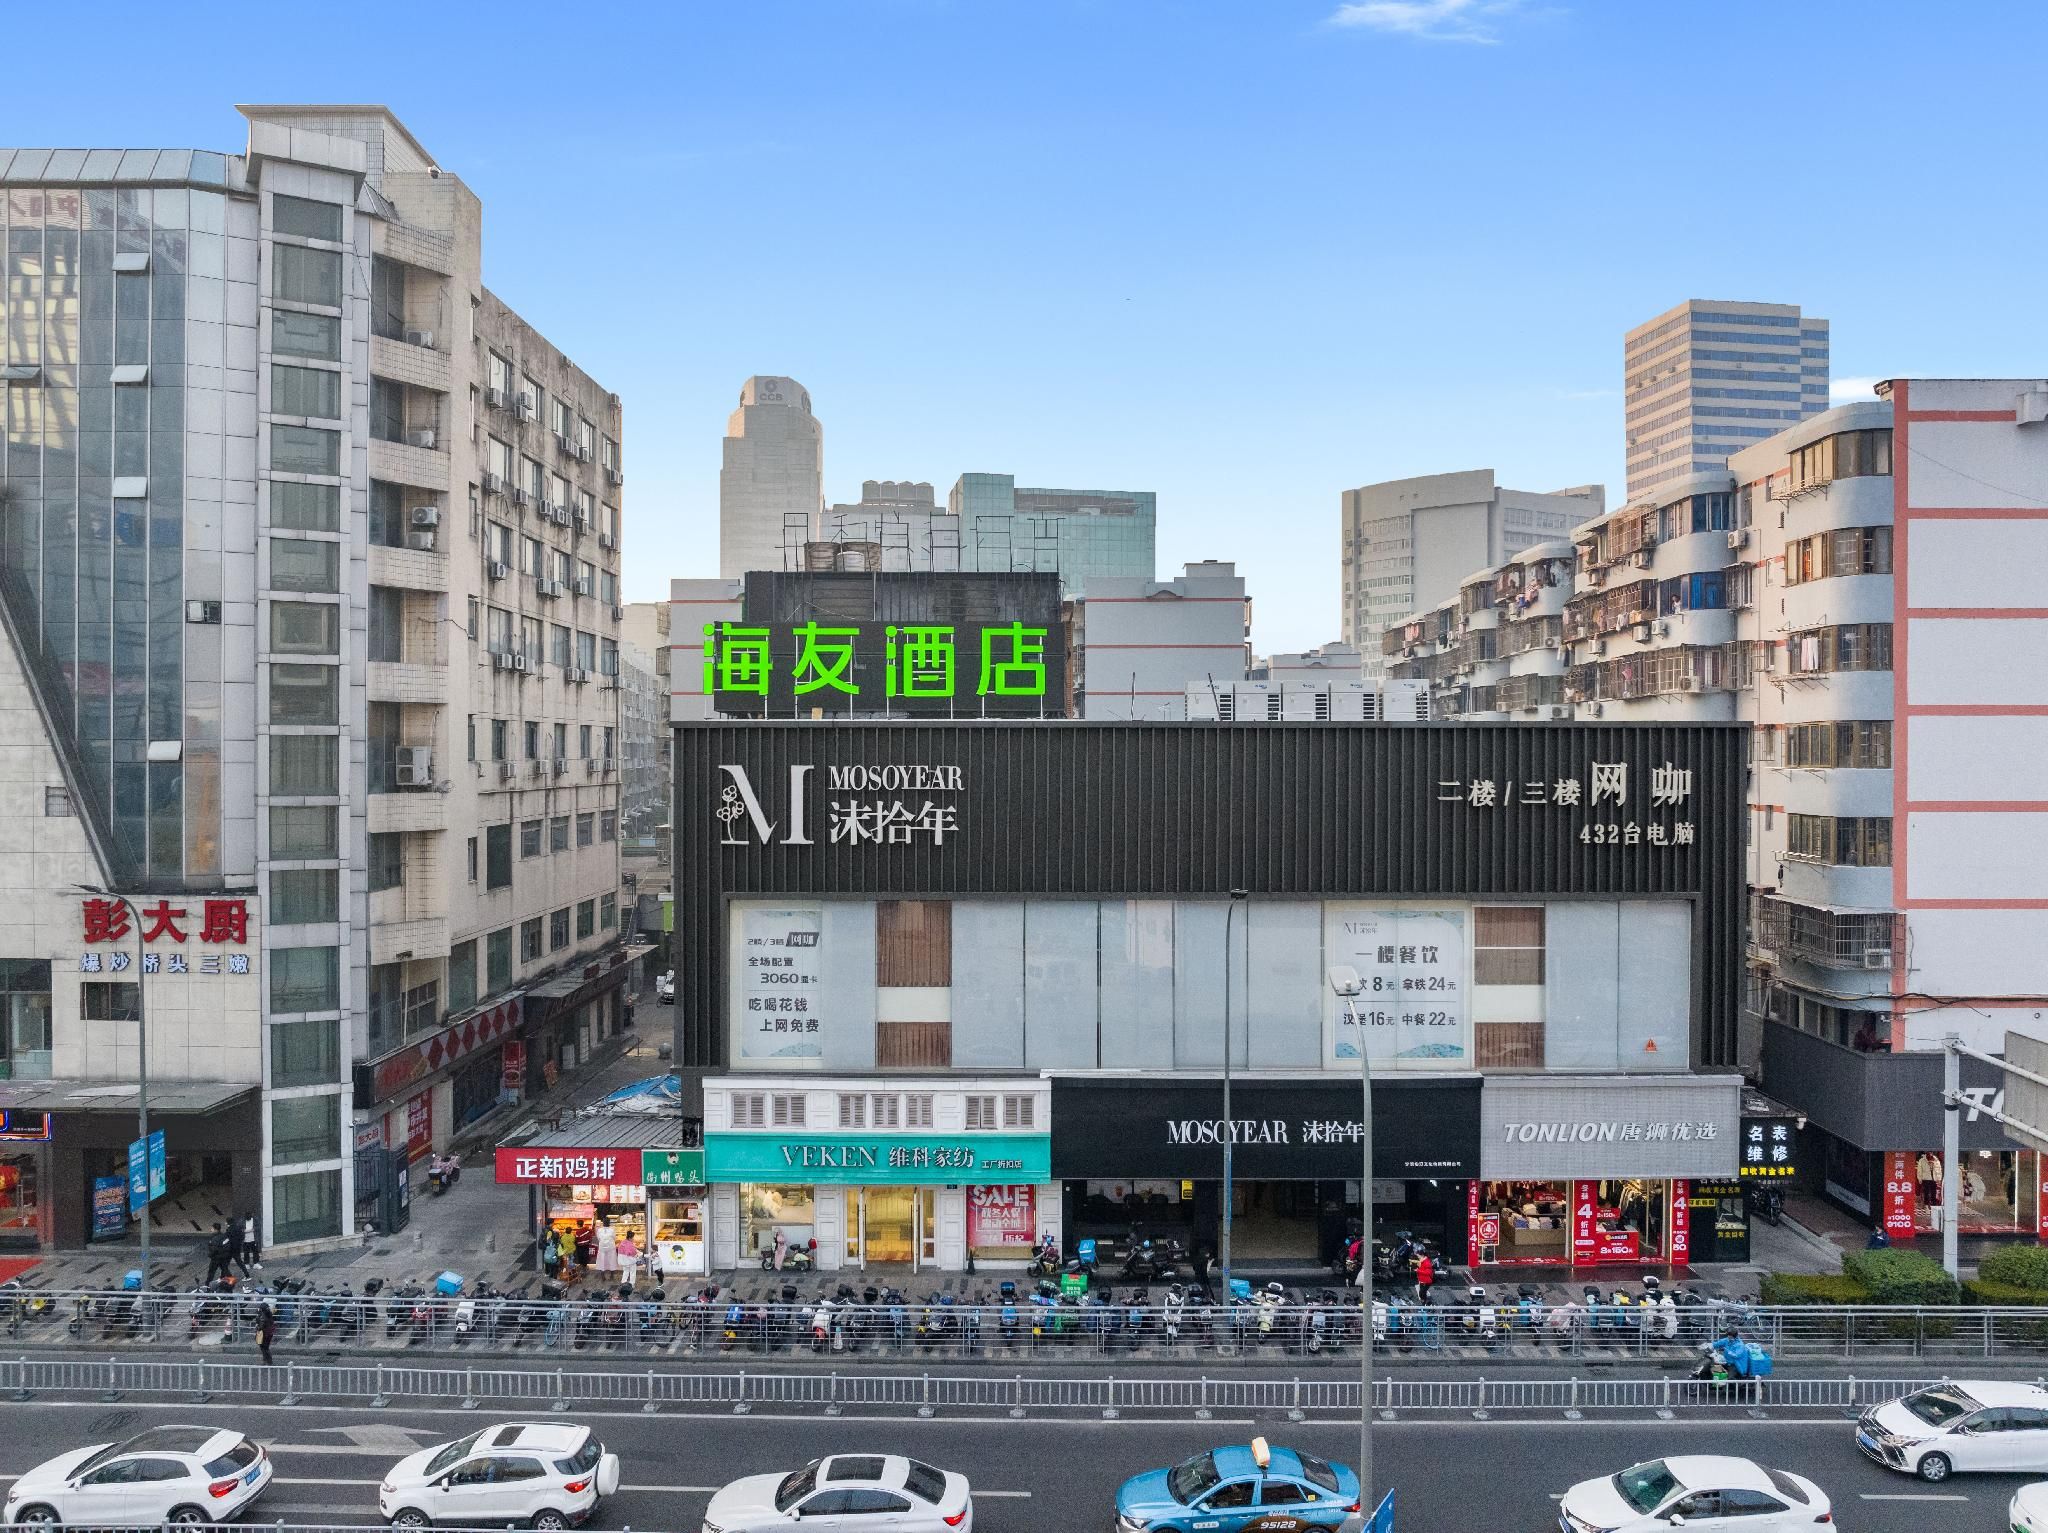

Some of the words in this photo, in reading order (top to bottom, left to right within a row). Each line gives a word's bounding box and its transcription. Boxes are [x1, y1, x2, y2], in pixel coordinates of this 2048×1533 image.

[759, 393, 783, 401] CCB
[703, 621, 1048, 697] 海友酒店
[828, 765, 965, 791] MOSOYEAR
[1591, 761, 1694, 807] 网咖
[716, 764, 815, 845] M
[829, 800, 960, 845] 沫拾年
[1580, 821, 1695, 845] 432台电脑
[82, 899, 249, 944] 彭大厨
[80, 952, 250, 974] 爆炒桥头三嫩
[748, 957, 794, 967] 全场配置
[1355, 945, 1438, 964] 一楼餐饮
[1402, 976, 1457, 991] 拿铁24元
[748, 997, 808, 1012] 吃喝花钱
[760, 1019, 819, 1033] 上网免费
[1504, 1122, 1617, 1143] TONLION
[1618, 1121, 1719, 1141] 唐狮优选
[1748, 1125, 1787, 1142] 名表
[781, 1146, 879, 1167] VEKEN
[888, 1146, 975, 1168] 维科家纺
[981, 1159, 1022, 1169] 工厂折扣店
[1747, 1145, 1788, 1162] 维修
[515, 1156, 617, 1179] 正新鸡排
[973, 1184, 1029, 1206] SALE
[1887, 1181, 1912, 1193] 8.8
[1260, 1520, 1297, 1529] 95128
